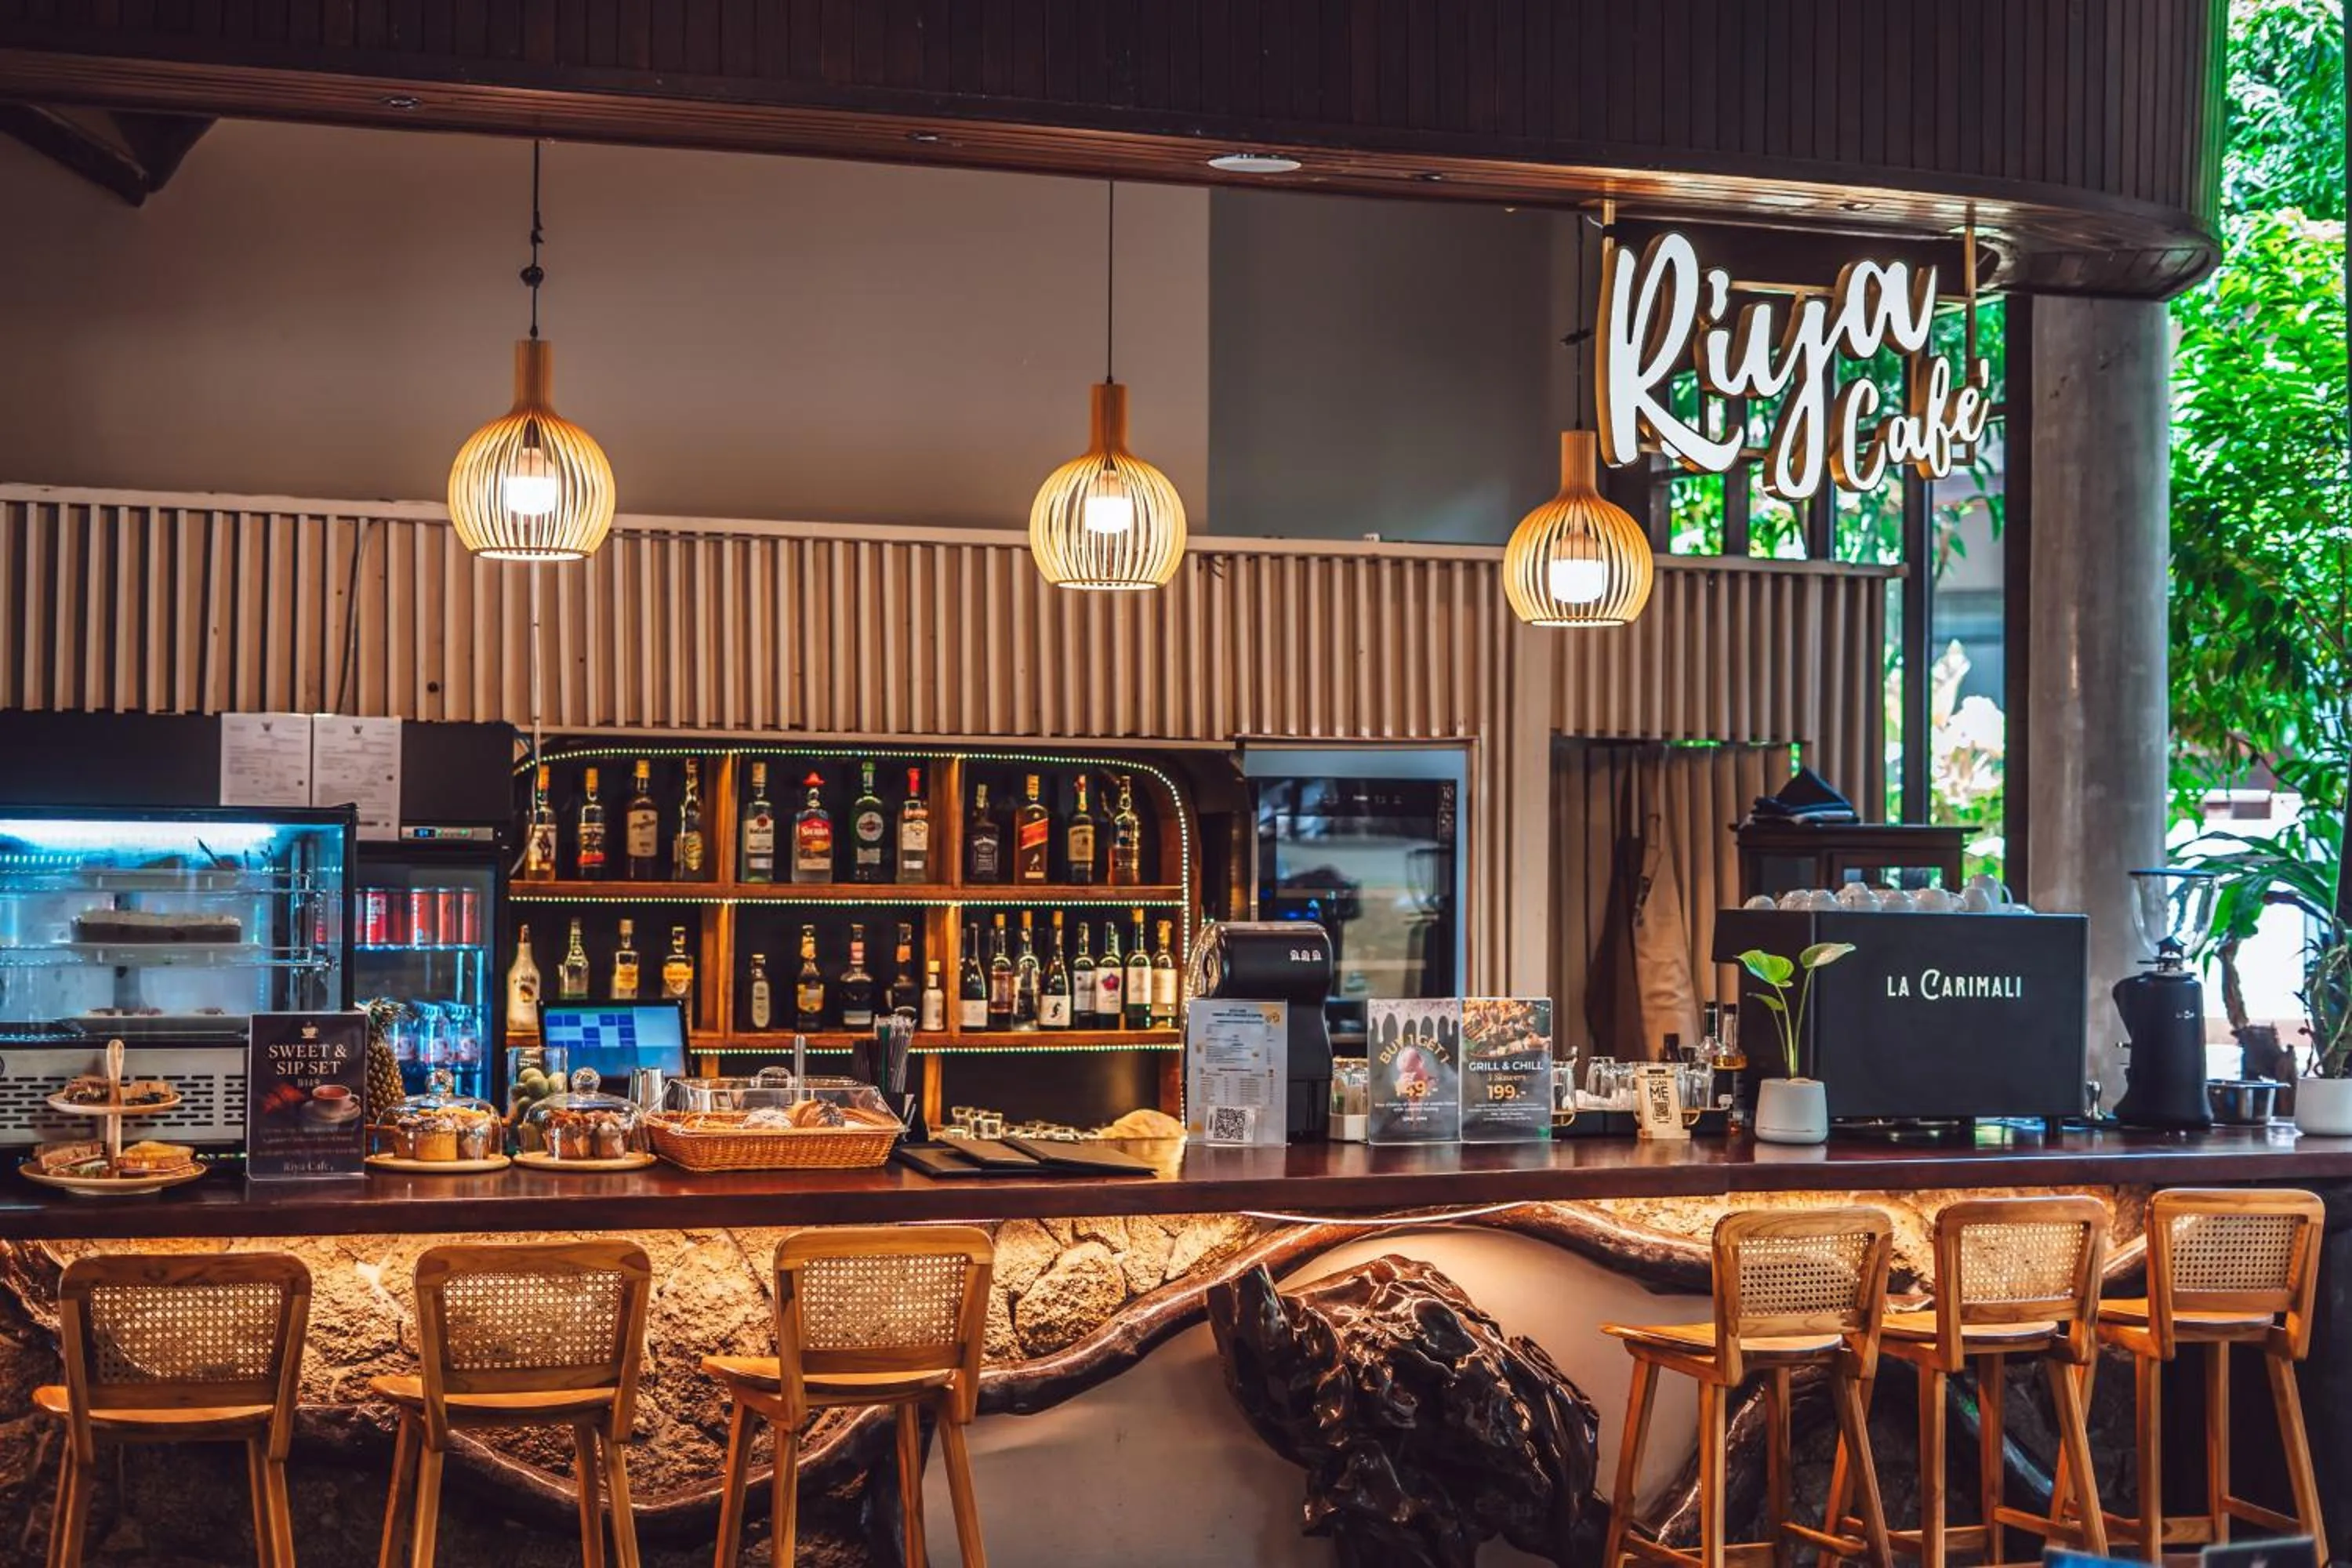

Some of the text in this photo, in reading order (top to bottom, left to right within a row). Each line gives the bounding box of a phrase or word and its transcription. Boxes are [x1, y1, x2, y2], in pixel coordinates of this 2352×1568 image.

[1607, 232, 1937, 499] Riya
[1886, 968, 2022, 1000] LA CARIMALI
[268, 1043, 347, 1058] SWEET &
[1379, 1037, 1404, 1064] BUY
[1417, 1034, 1446, 1054] GET
[276, 1061, 341, 1075] SIP SET
[1468, 1061, 1544, 1071] GRILL & CHILL
[1486, 1084, 1527, 1100] 199.-
[1649, 1086, 1669, 1098] ME
